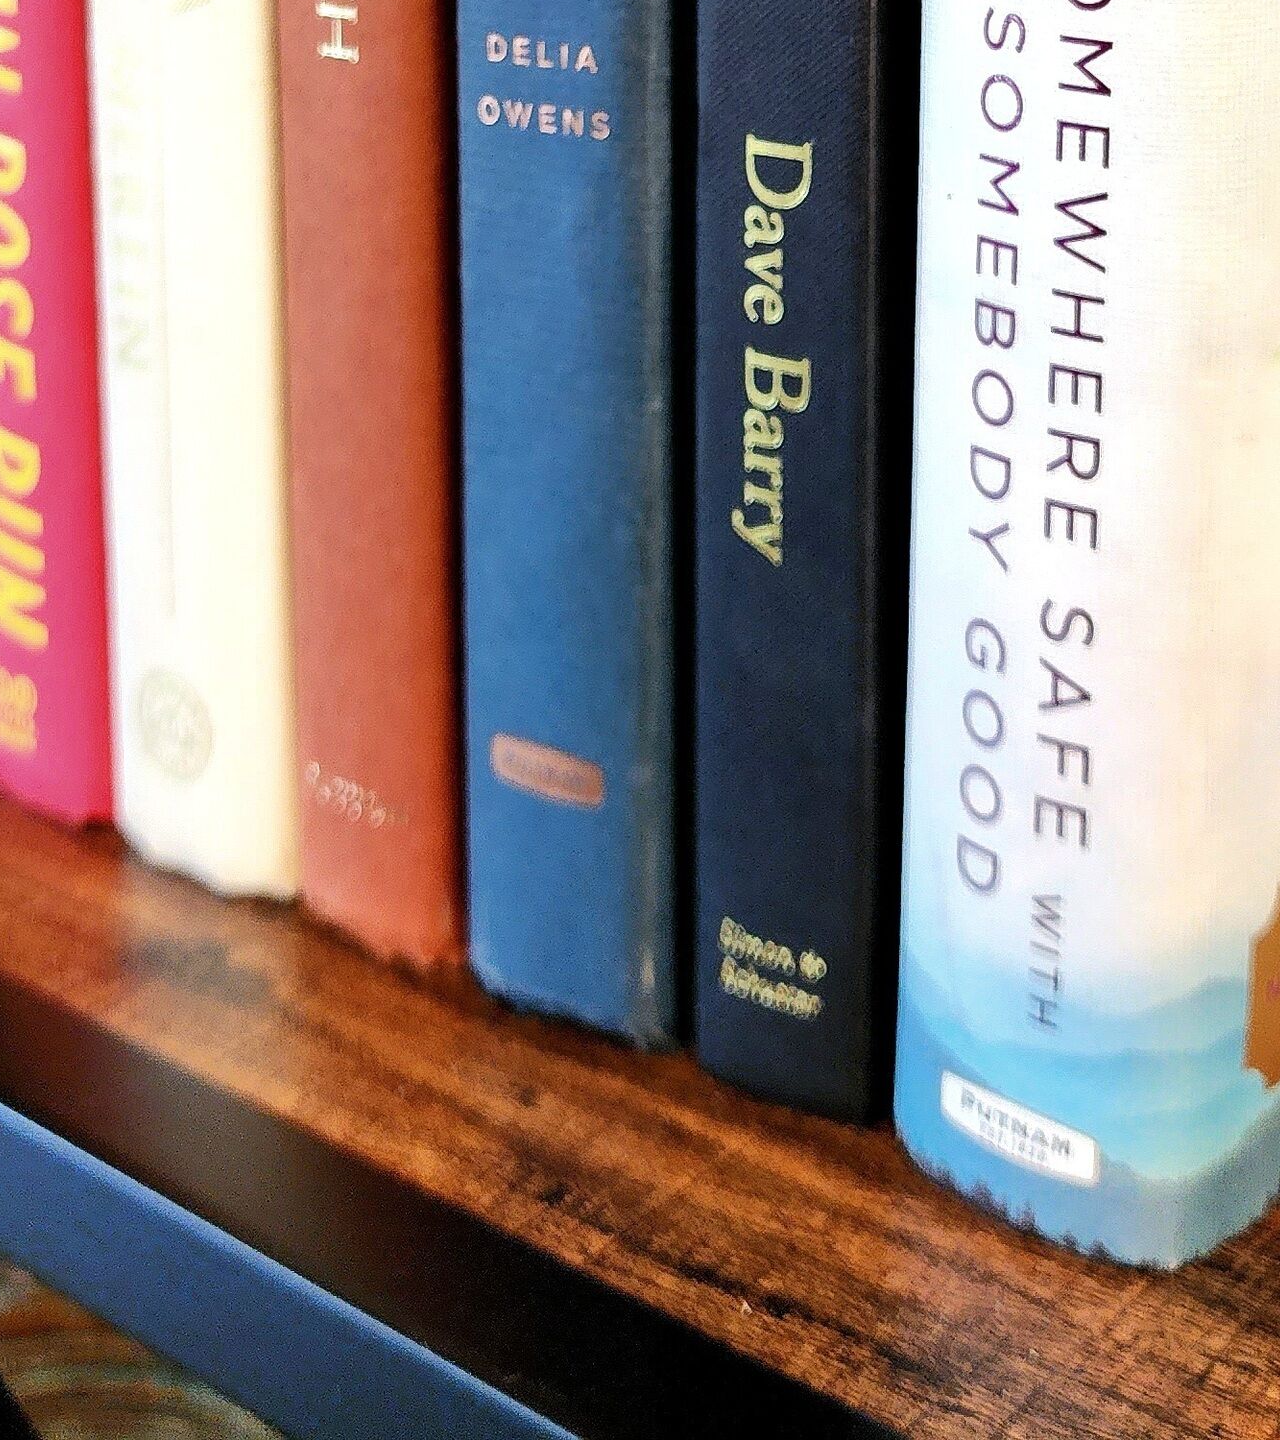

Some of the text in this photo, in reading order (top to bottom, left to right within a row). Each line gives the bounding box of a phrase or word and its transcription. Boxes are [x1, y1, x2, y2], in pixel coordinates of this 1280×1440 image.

[477, 91, 612, 142] OWENS
[485, 30, 599, 76] DELIA
[731, 132, 815, 568] Dave Barry
[956, 6, 1027, 896] SOMEBODY GOOD
[1032, 597, 1097, 852] SAFE
[1026, 890, 1064, 1032] WITH
